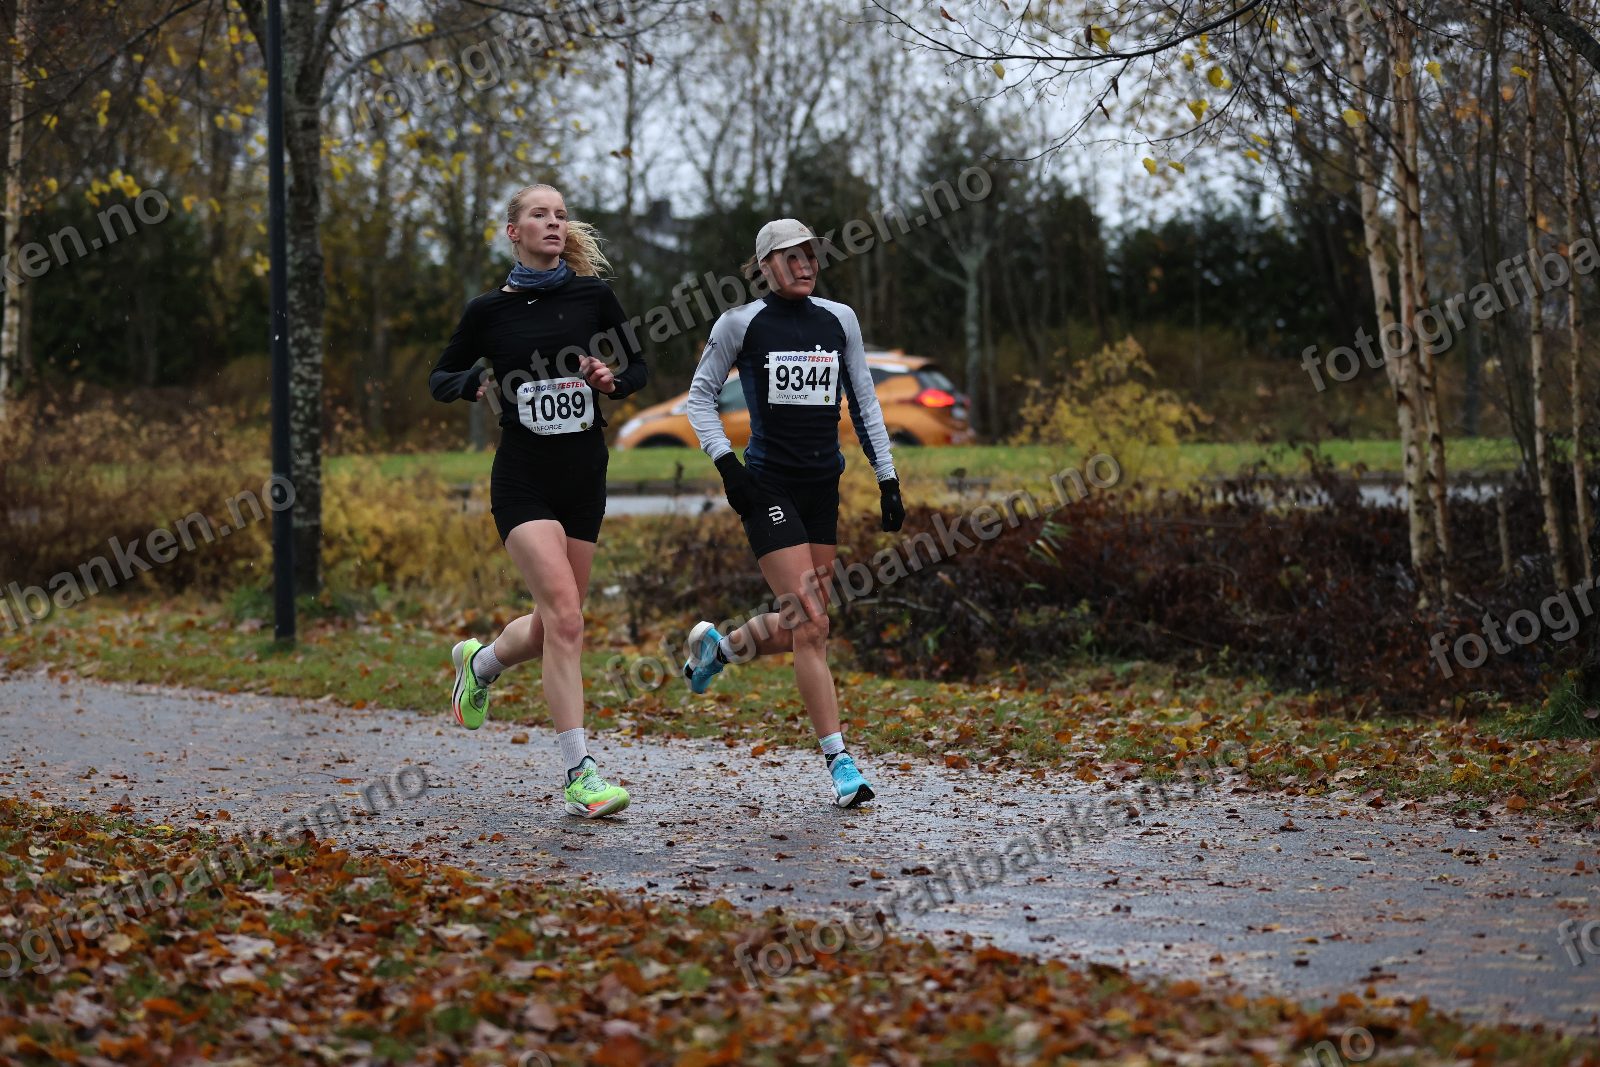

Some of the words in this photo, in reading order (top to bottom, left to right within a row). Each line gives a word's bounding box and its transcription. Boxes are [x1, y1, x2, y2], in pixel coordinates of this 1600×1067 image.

[776, 355, 833, 363] NORGESTESTEN
[523, 381, 585, 394] NORGESTESTEN
[775, 365, 831, 391] 9344
[525, 391, 586, 422] 1089
